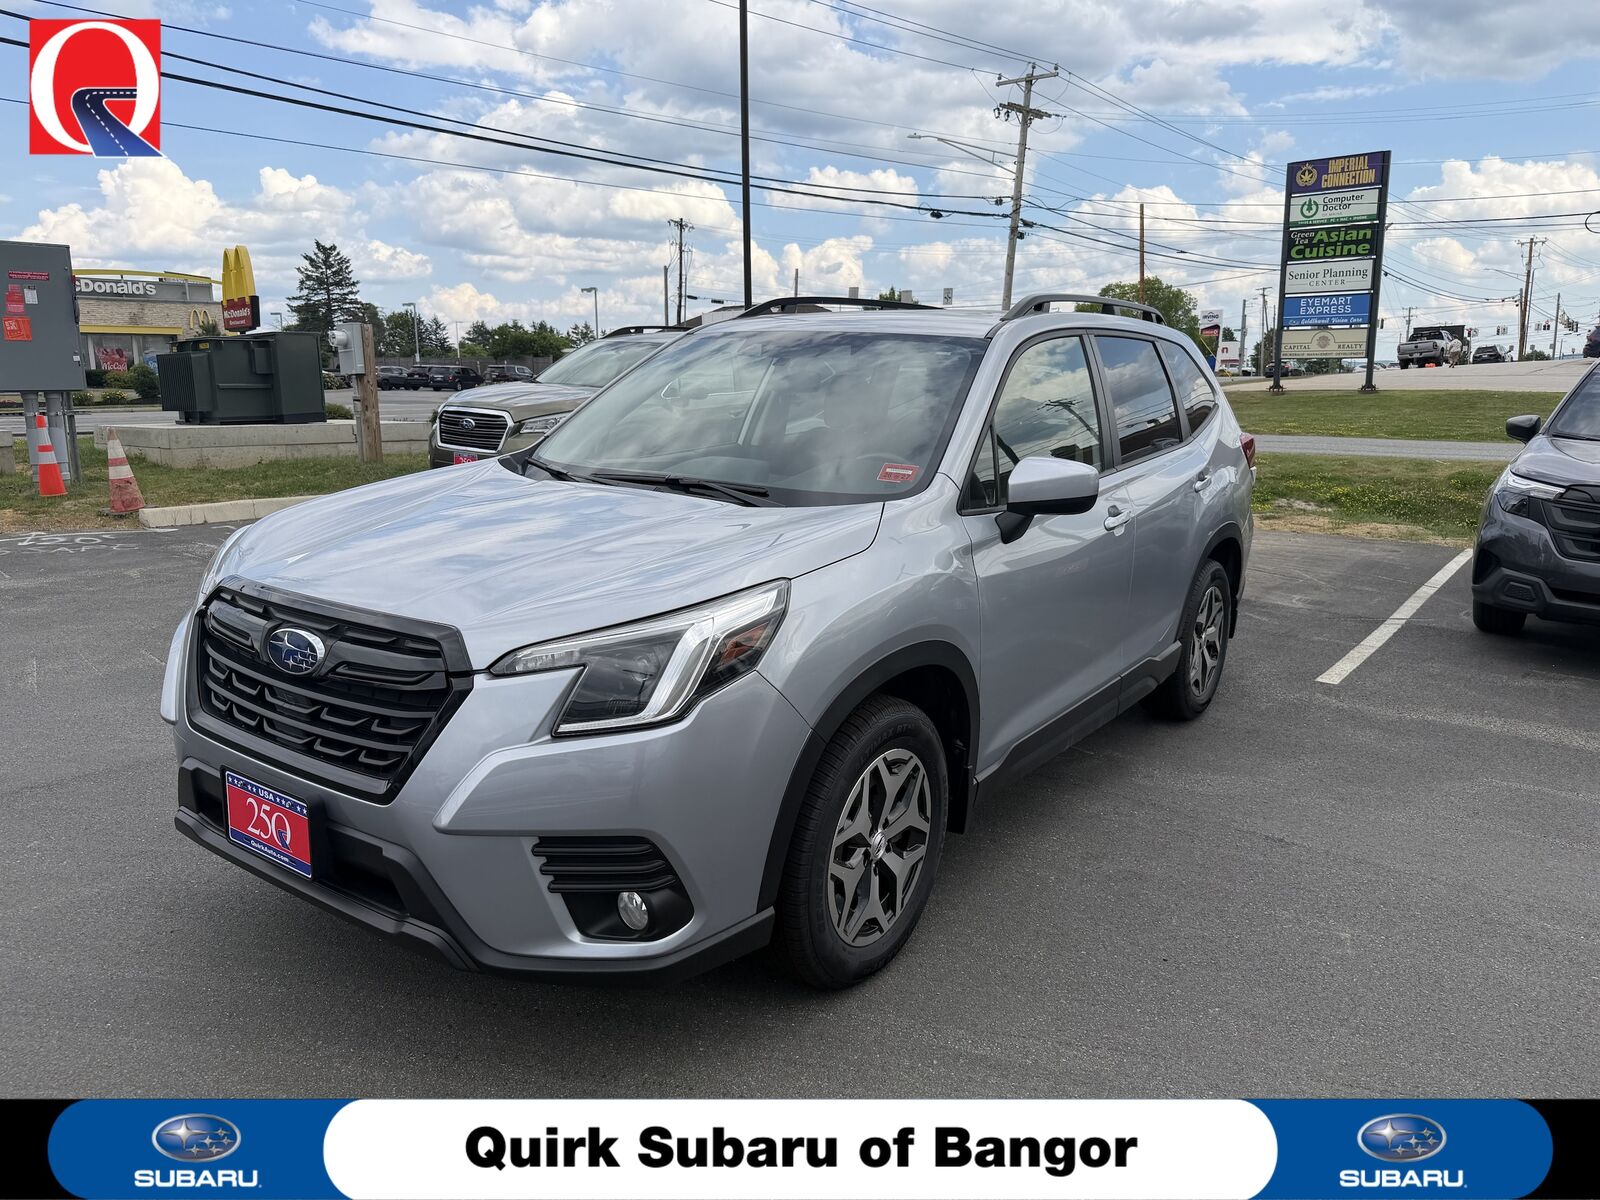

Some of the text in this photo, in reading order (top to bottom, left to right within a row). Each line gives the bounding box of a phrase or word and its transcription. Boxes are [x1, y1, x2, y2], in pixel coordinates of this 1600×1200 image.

[1328, 156, 1369, 173] IMPERIAL
[1321, 169, 1376, 188] CONNECTION
[1322, 194, 1365, 205] Computer
[1322, 203, 1352, 212] Doctor
[1290, 231, 1315, 239] Green
[1312, 227, 1372, 243] Asian
[1290, 243, 1371, 259] Cuisine
[1288, 267, 1369, 280] Senior Planning
[75, 278, 157, 295] cDonald's
[1308, 279, 1346, 287] CENTER
[1300, 296, 1352, 306] EYEMART
[223, 307, 251, 319] McDonald's
[1300, 305, 1352, 315] EXPRESS
[258, 788, 274, 802] USA
[250, 839, 289, 863] QuirkAuto.com
